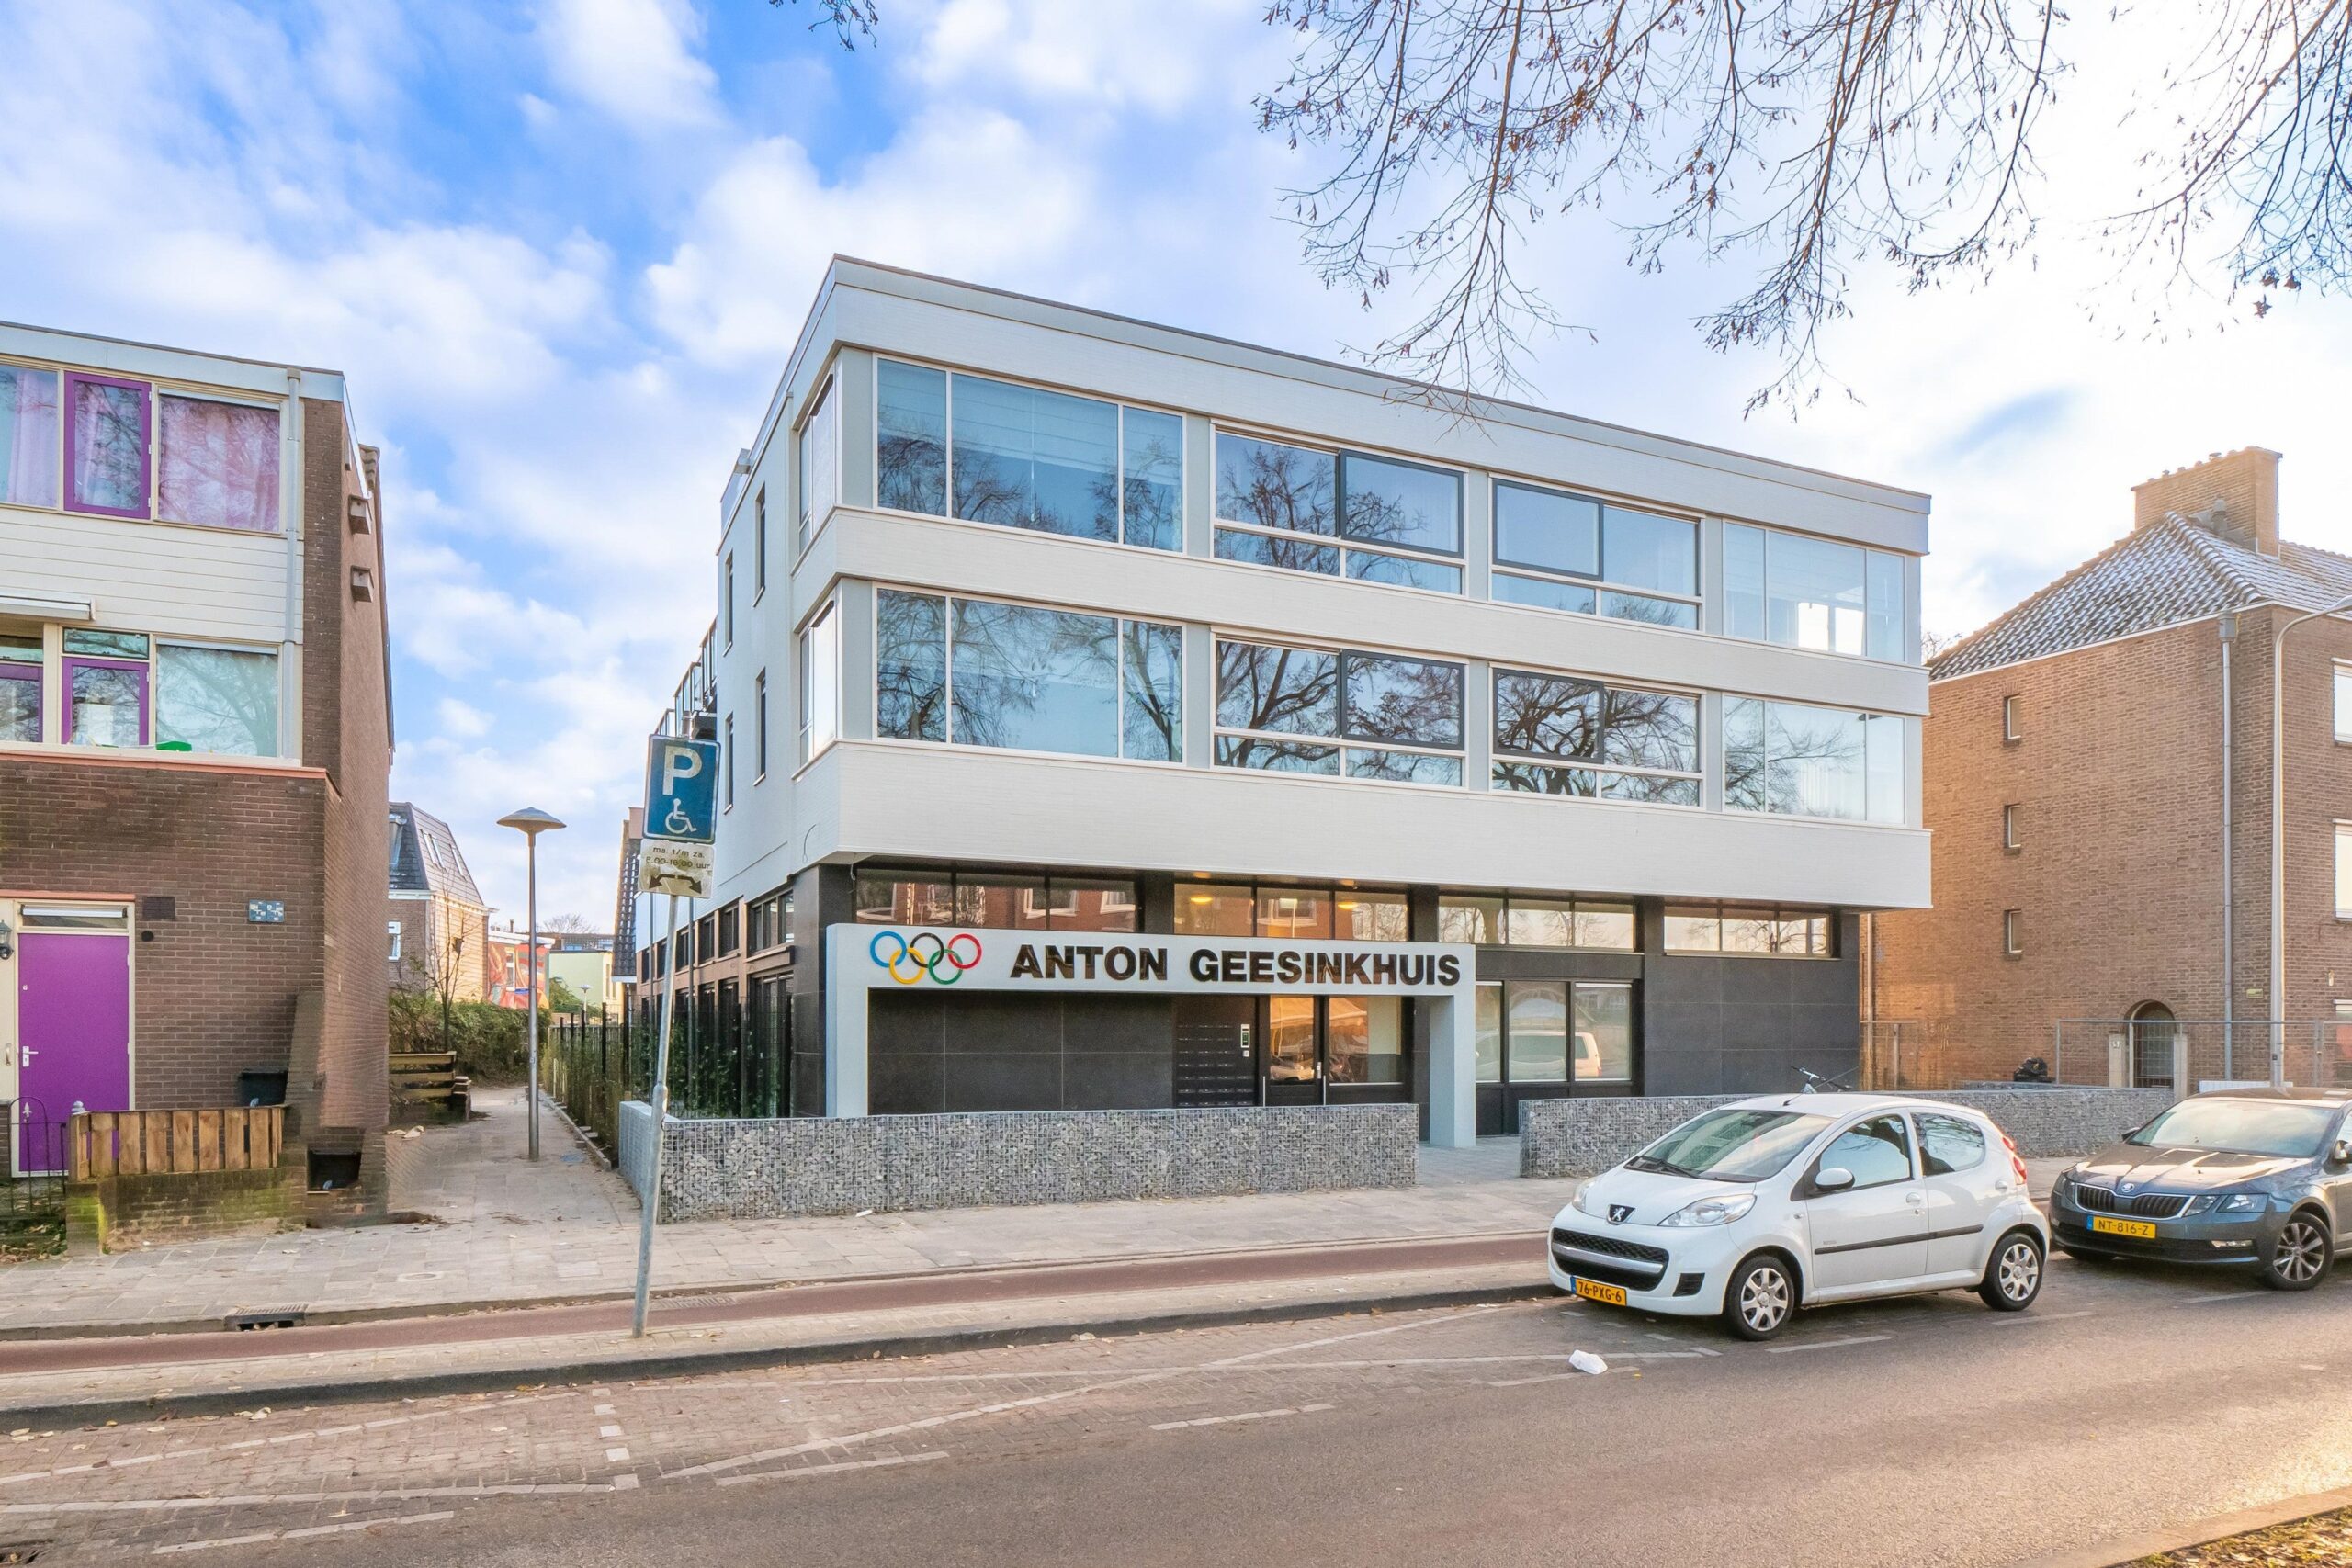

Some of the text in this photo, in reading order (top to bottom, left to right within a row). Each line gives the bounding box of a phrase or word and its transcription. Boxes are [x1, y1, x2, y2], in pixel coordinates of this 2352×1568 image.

[662, 745, 703, 795] P
[672, 849, 689, 857] t/m
[1010, 944, 1461, 986] ANTON GEESINKHUIS
[2098, 1219, 2149, 1235] NT-816-Z
[1578, 1281, 1622, 1303] 76-PXG-6
